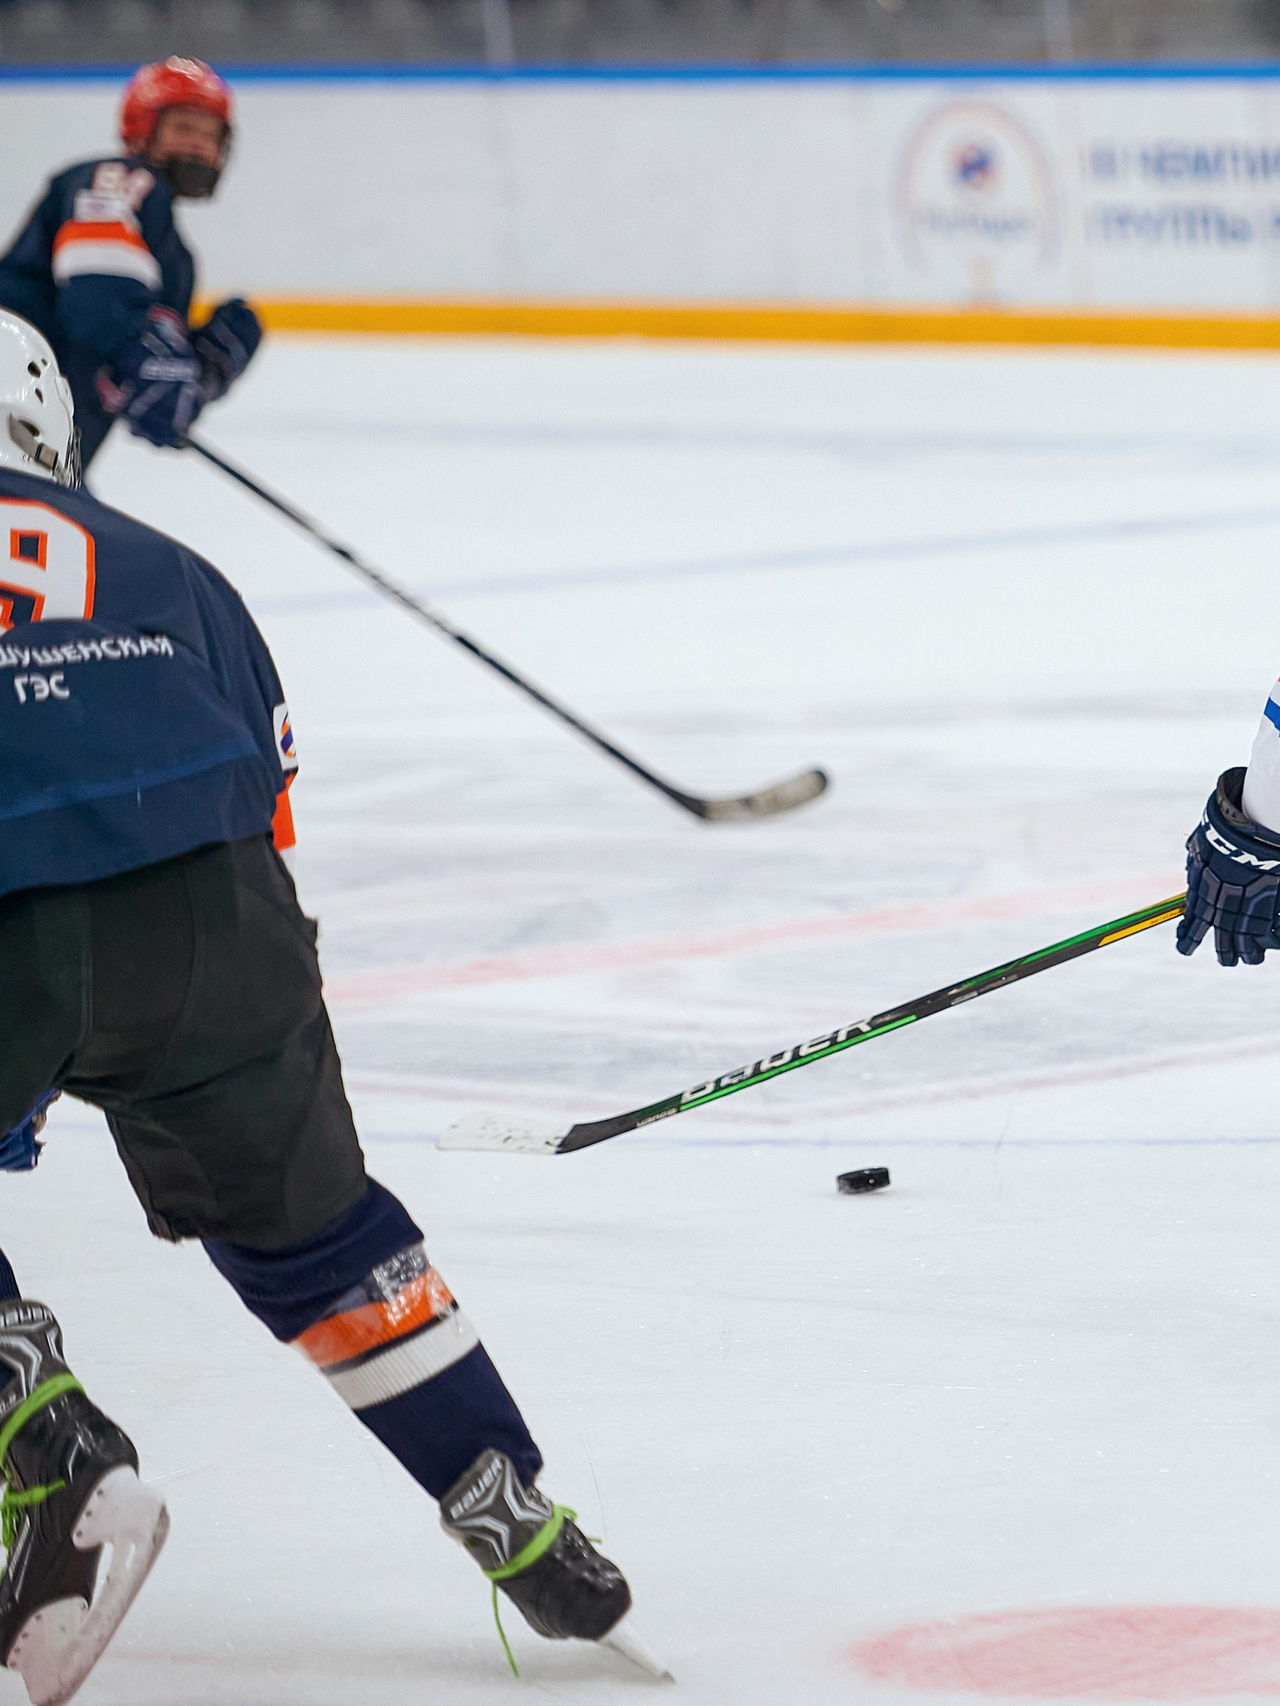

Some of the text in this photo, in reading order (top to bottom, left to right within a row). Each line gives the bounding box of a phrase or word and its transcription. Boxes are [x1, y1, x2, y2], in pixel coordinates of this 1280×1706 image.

[14, 671, 70, 704] ГЭС
[0, 1305, 54, 1328] AUER
[449, 1457, 503, 1520] BAUER
